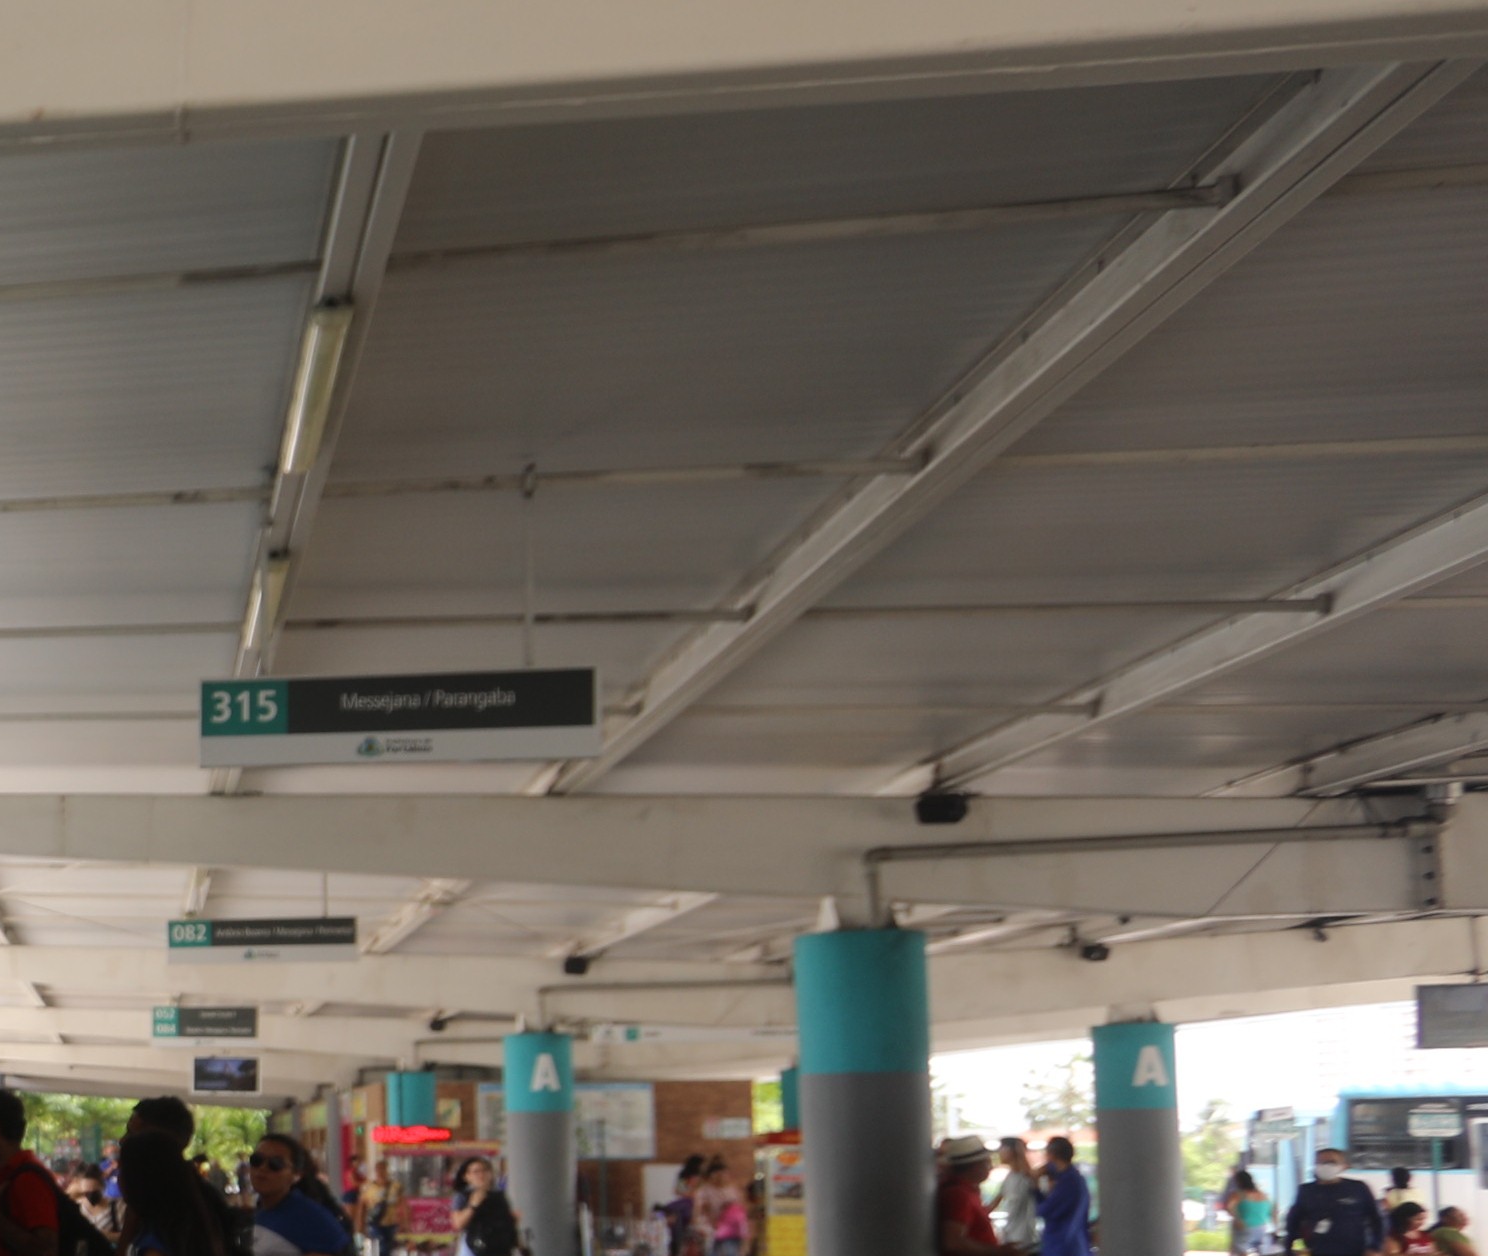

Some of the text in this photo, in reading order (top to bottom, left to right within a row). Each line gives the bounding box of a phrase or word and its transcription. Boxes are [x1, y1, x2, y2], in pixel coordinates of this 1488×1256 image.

[210, 689, 279, 723] 315
[434, 687, 516, 712] Parangaba
[173, 923, 207, 943] 082
[529, 1053, 561, 1092] A
[1131, 1045, 1169, 1087] A
